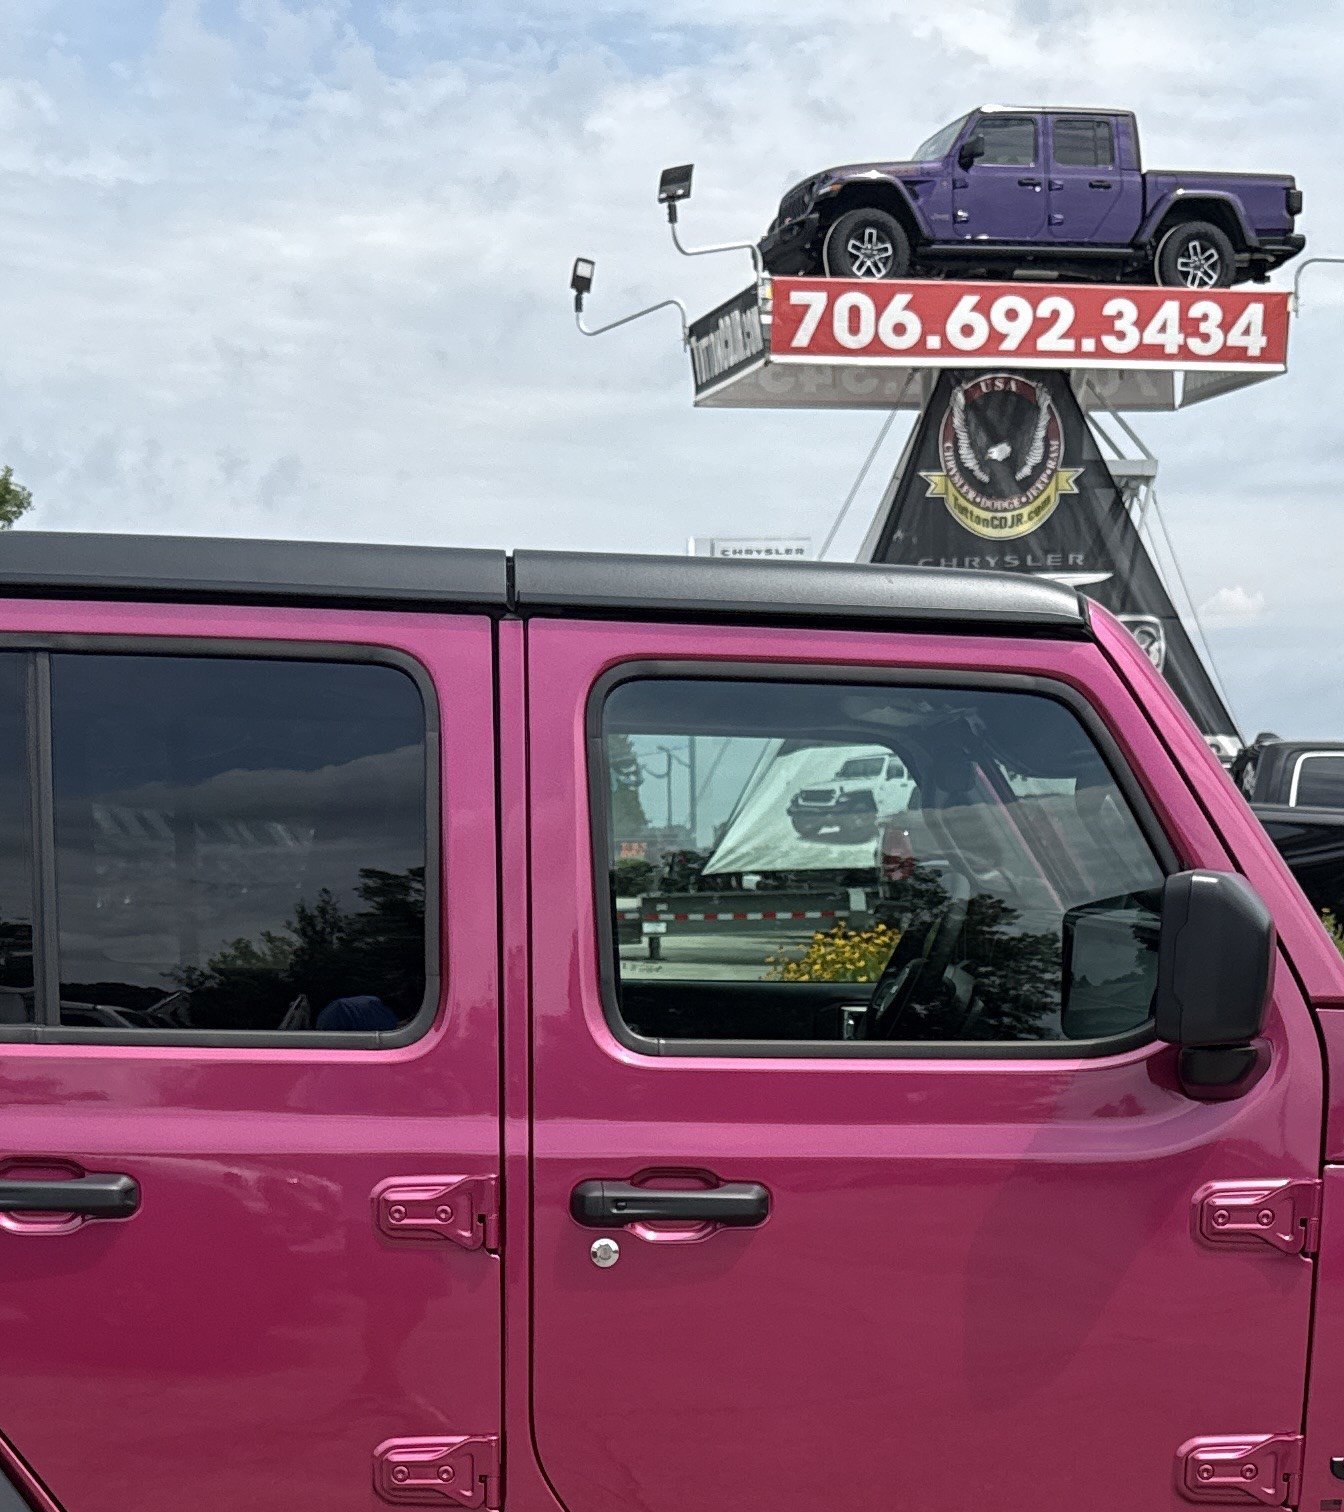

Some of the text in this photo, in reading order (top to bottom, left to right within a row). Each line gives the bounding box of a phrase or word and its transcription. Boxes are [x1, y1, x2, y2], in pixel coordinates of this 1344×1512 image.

[788, 291, 1267, 356] 706.692.3434
[979, 378, 1018, 393] USA
[719, 547, 805, 557] CHRYSLER
[917, 553, 1085, 568] CHRYSLER
